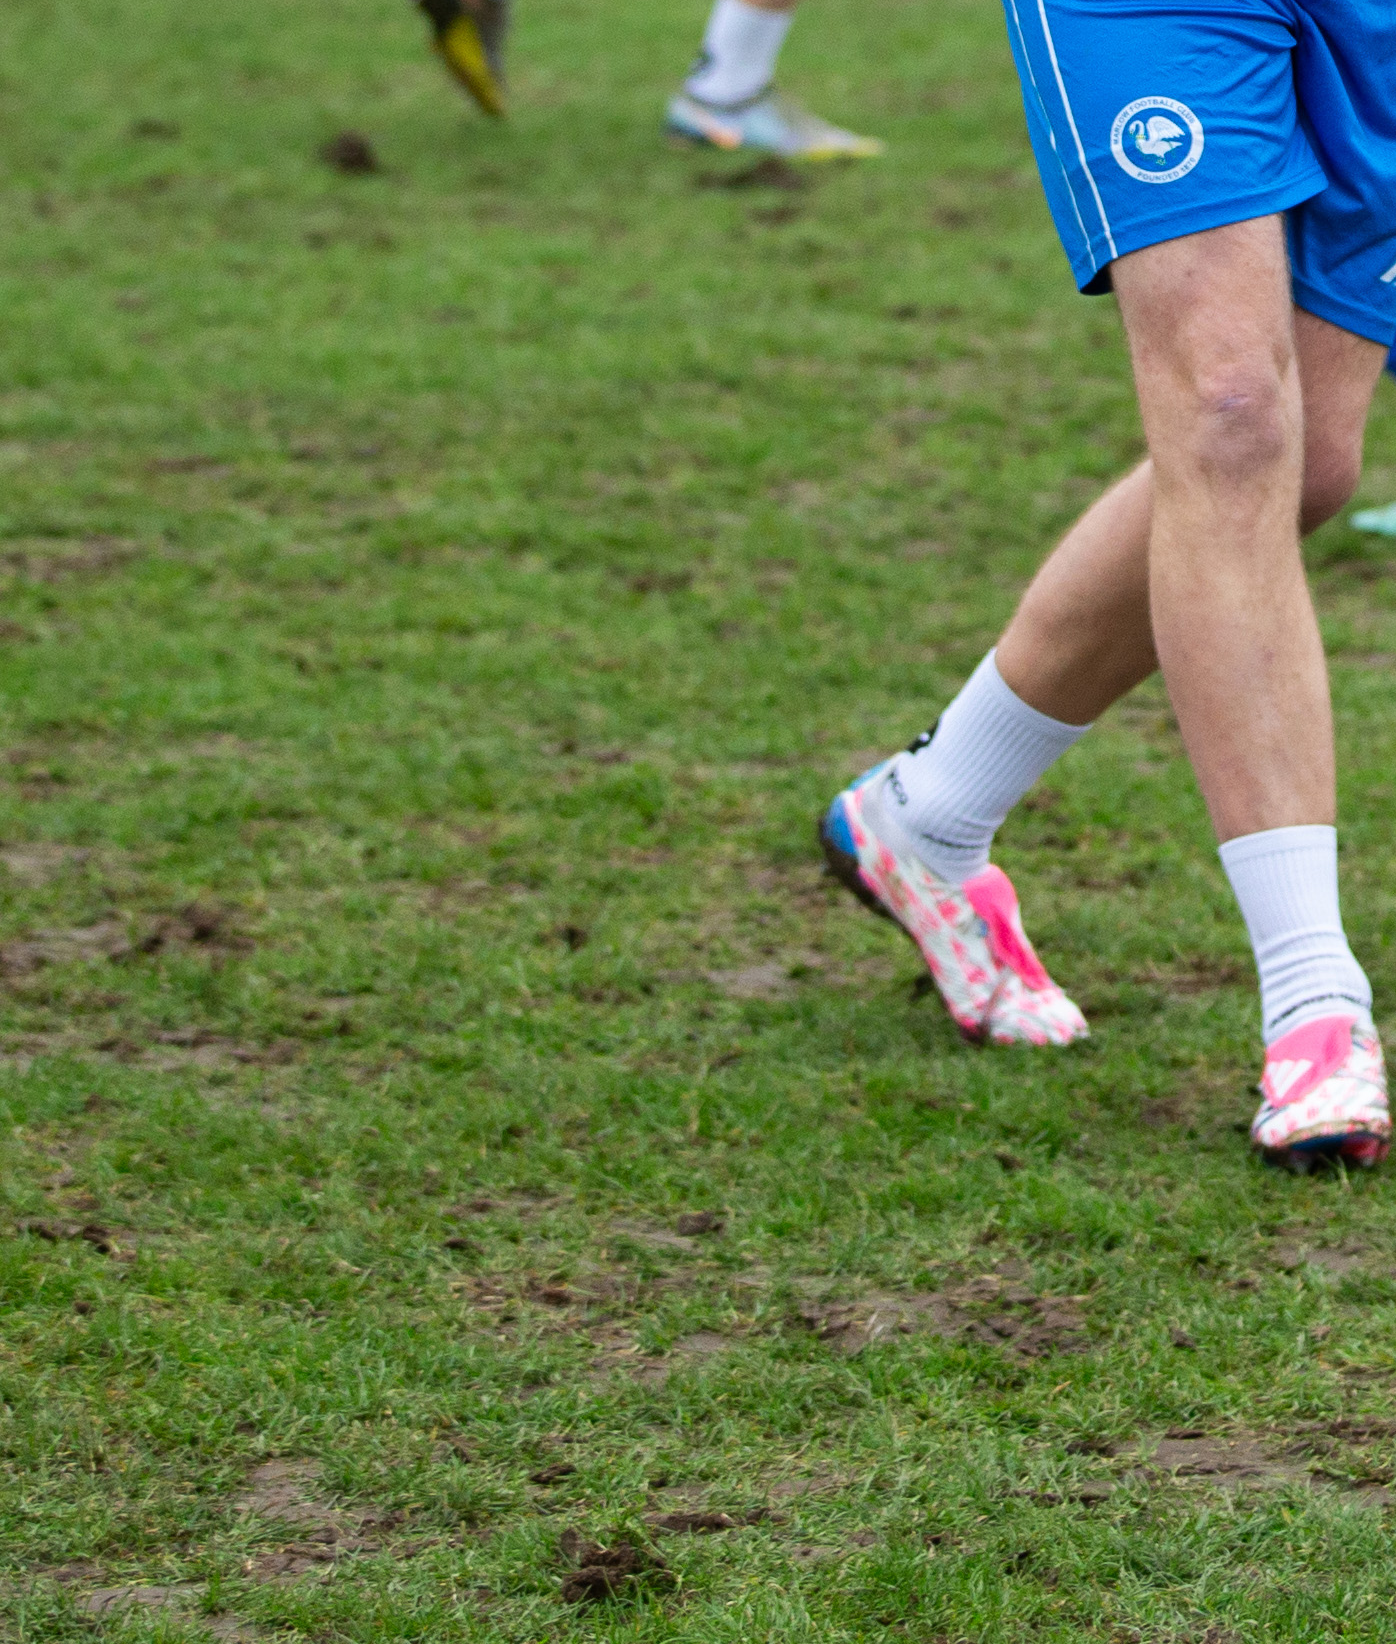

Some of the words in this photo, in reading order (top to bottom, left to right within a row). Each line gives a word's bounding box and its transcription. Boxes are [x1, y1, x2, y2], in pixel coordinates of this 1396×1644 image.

[1113, 109, 1130, 145] MARLOW
[1129, 98, 1175, 113] FOOTBALL
[1176, 105, 1196, 124] CLUB
[1136, 171, 1180, 182] FOUNDED
